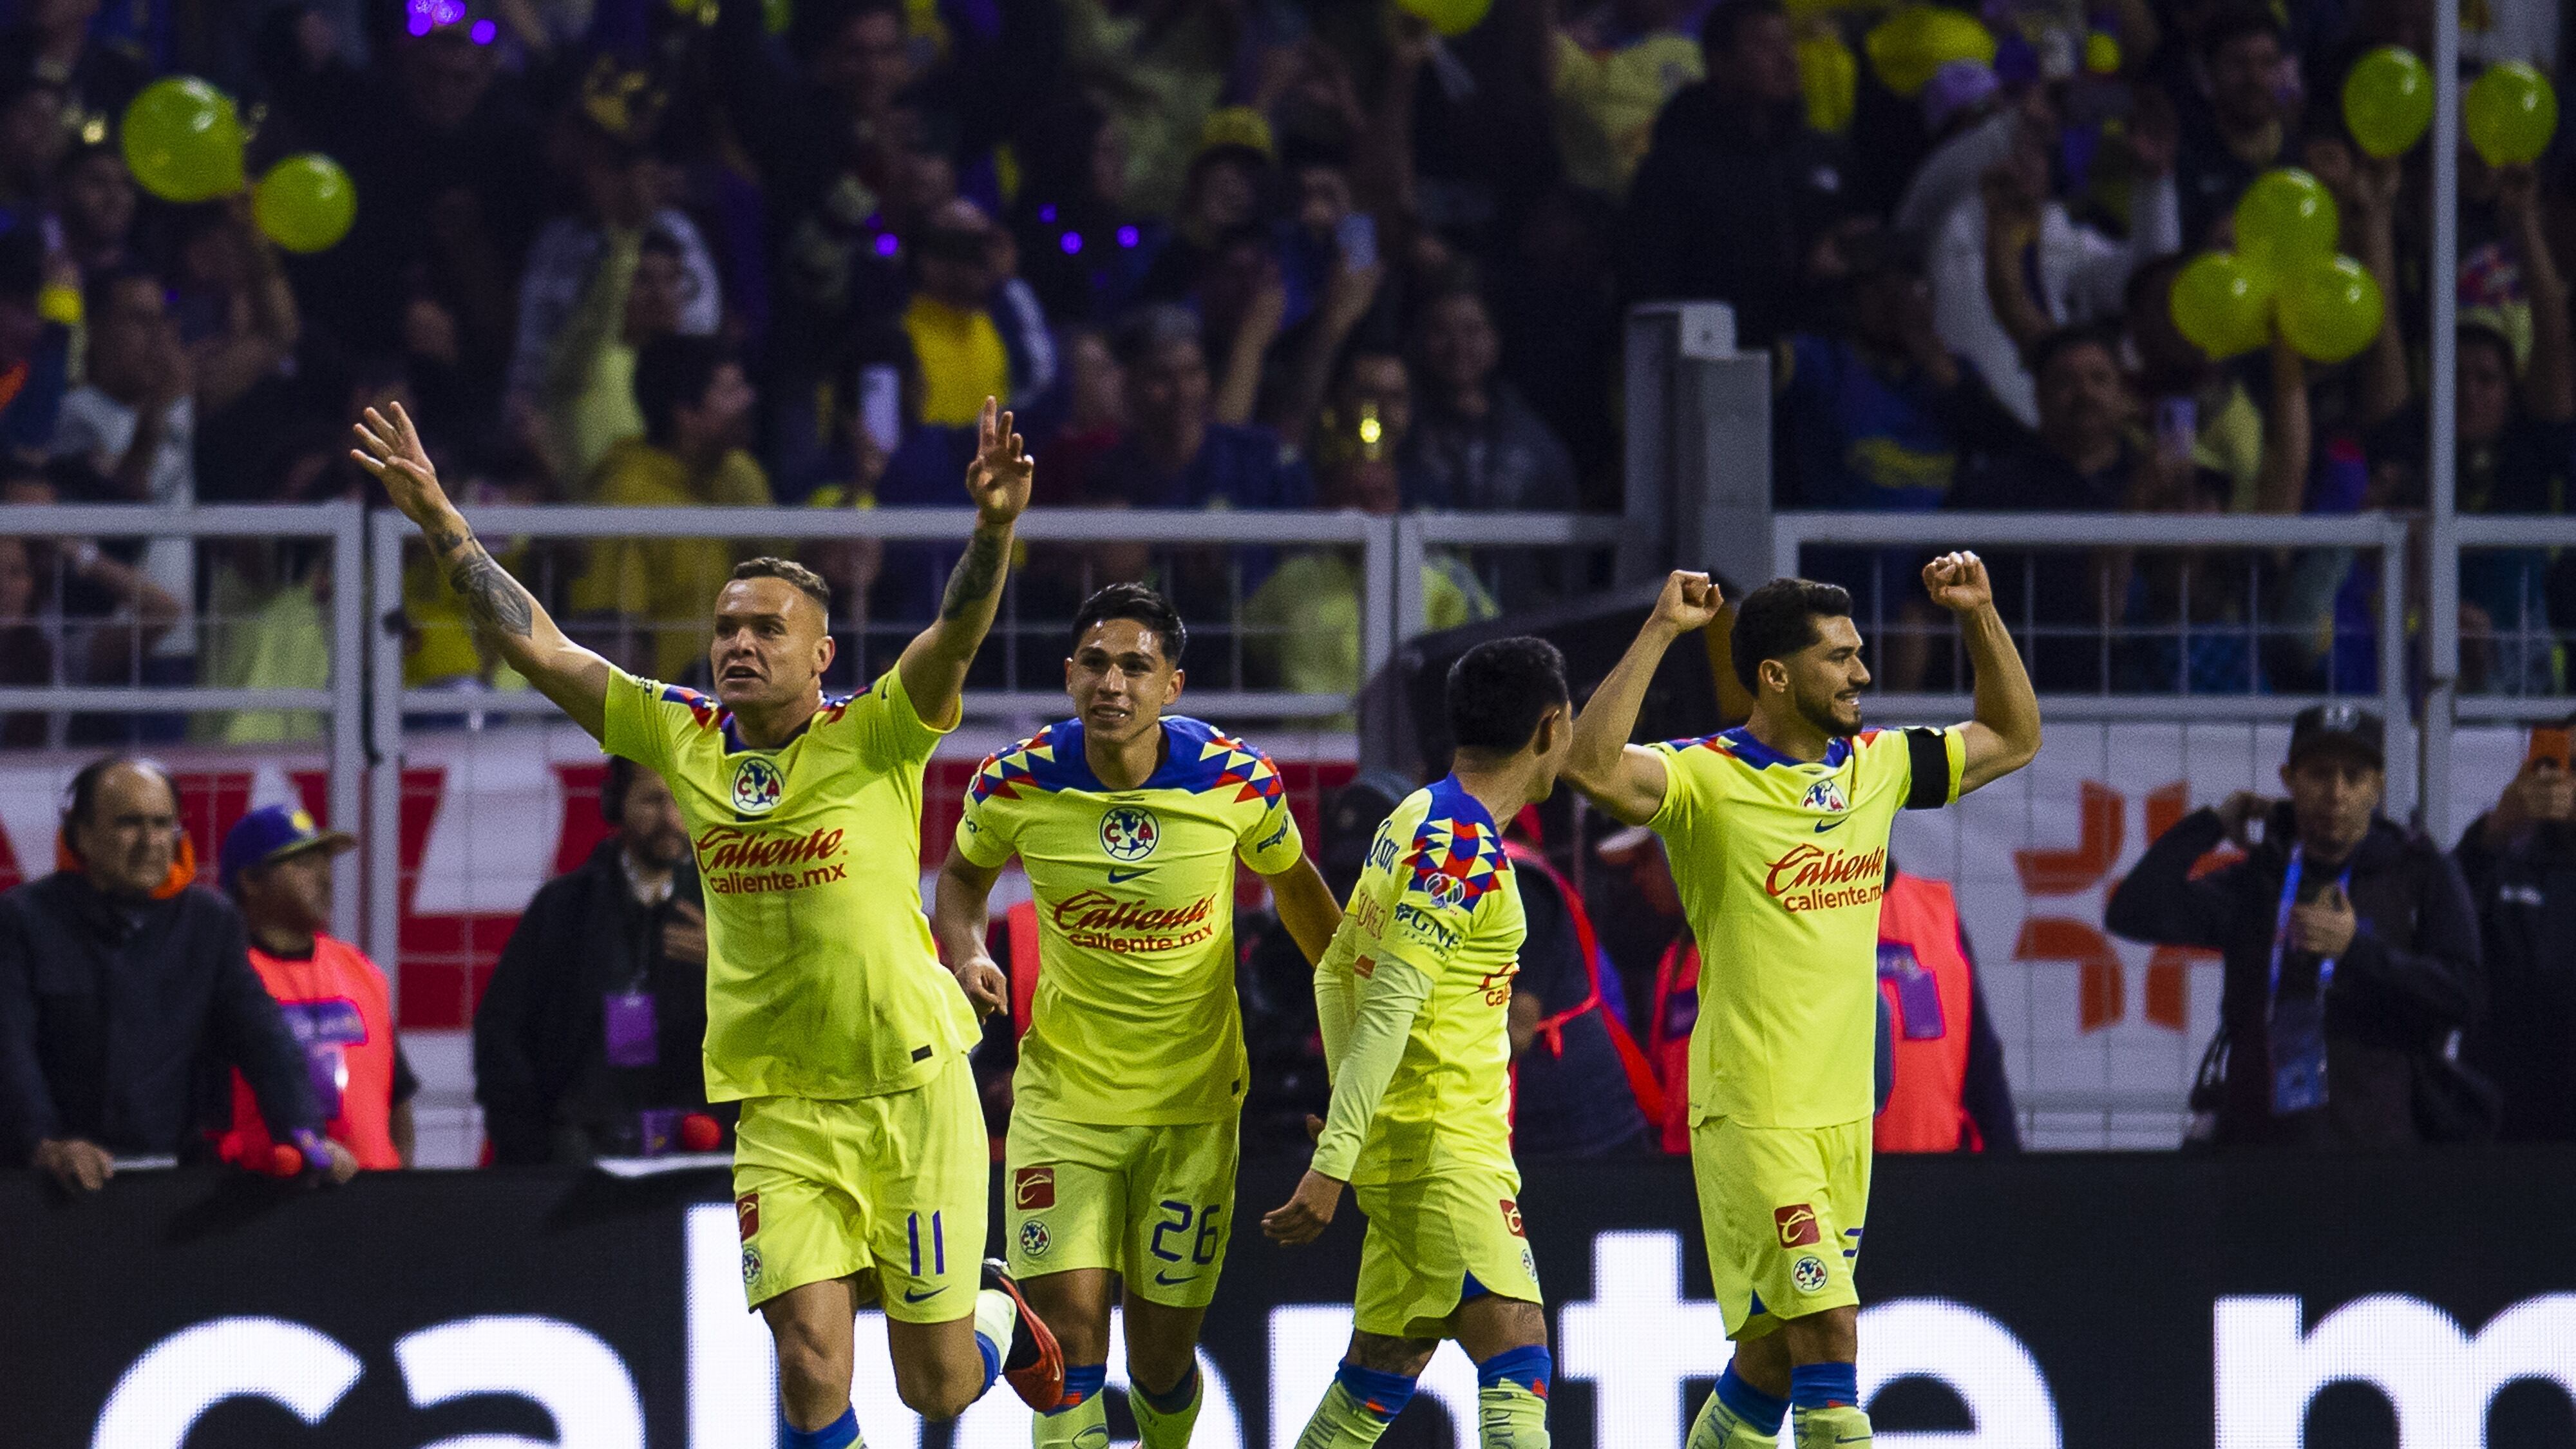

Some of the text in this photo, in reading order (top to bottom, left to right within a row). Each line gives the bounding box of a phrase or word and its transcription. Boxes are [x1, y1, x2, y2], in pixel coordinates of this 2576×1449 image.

[695, 825, 844, 874] Caliente
[710, 862, 848, 895] caliente.mx
[1068, 922, 1213, 954] caliente.mx
[907, 1209, 945, 1277] 11
[1150, 1199, 1221, 1266] 26
